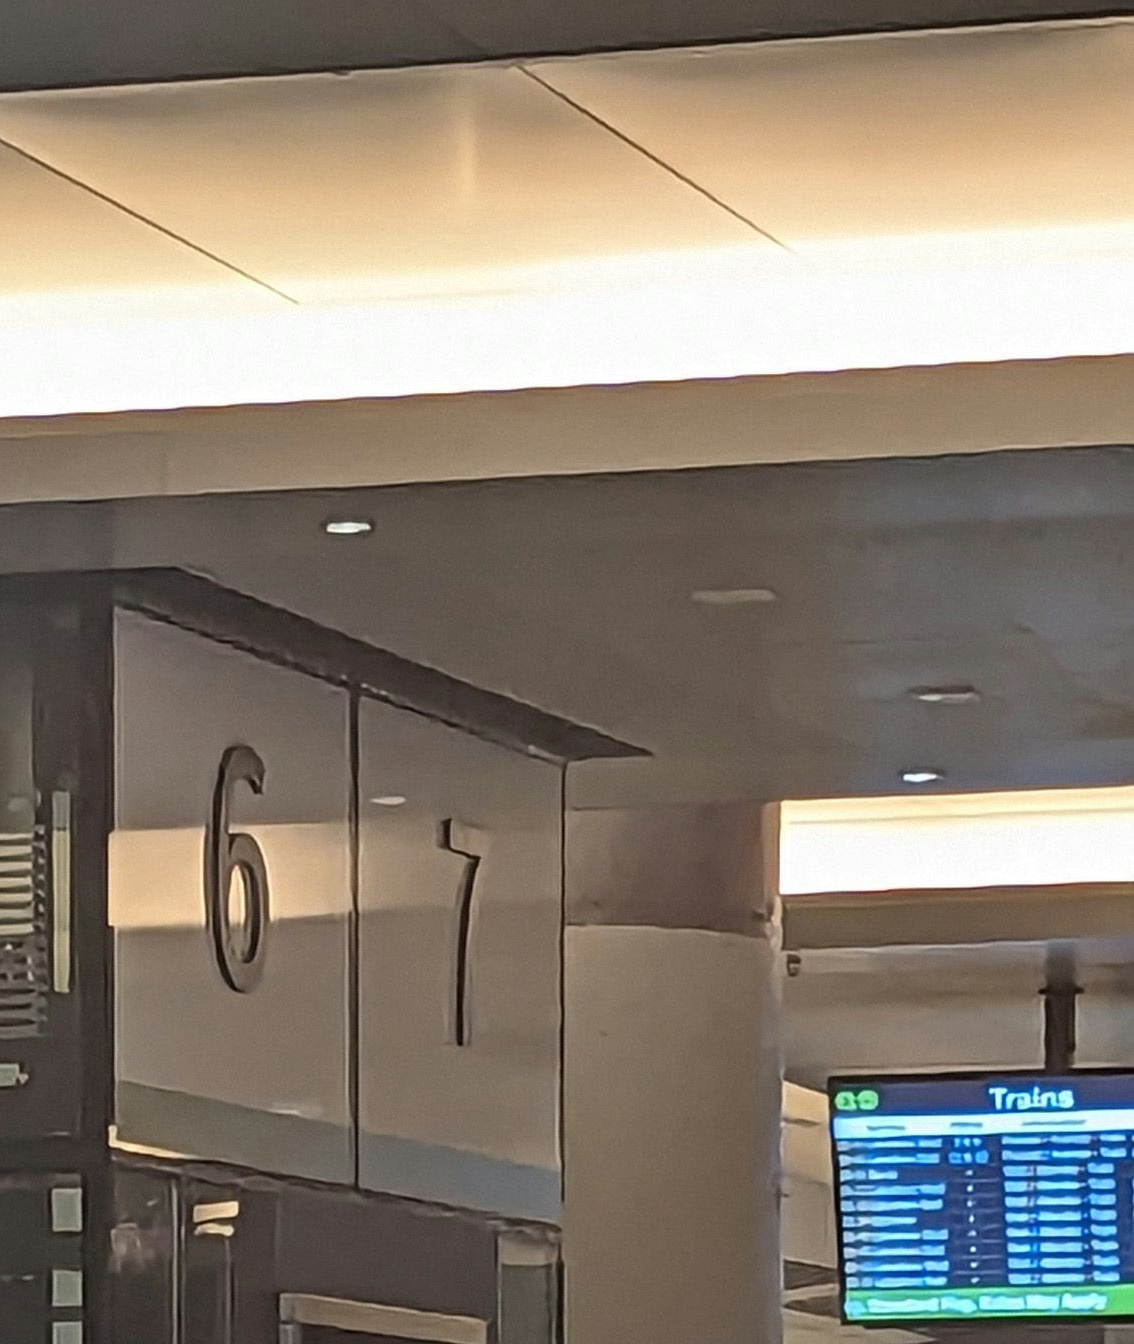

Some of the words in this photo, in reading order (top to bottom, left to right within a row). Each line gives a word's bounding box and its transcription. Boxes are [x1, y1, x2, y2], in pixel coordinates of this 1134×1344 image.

[204, 744, 270, 994] 6
[436, 816, 488, 1047] 7
[988, 1085, 1075, 1111] Trains
